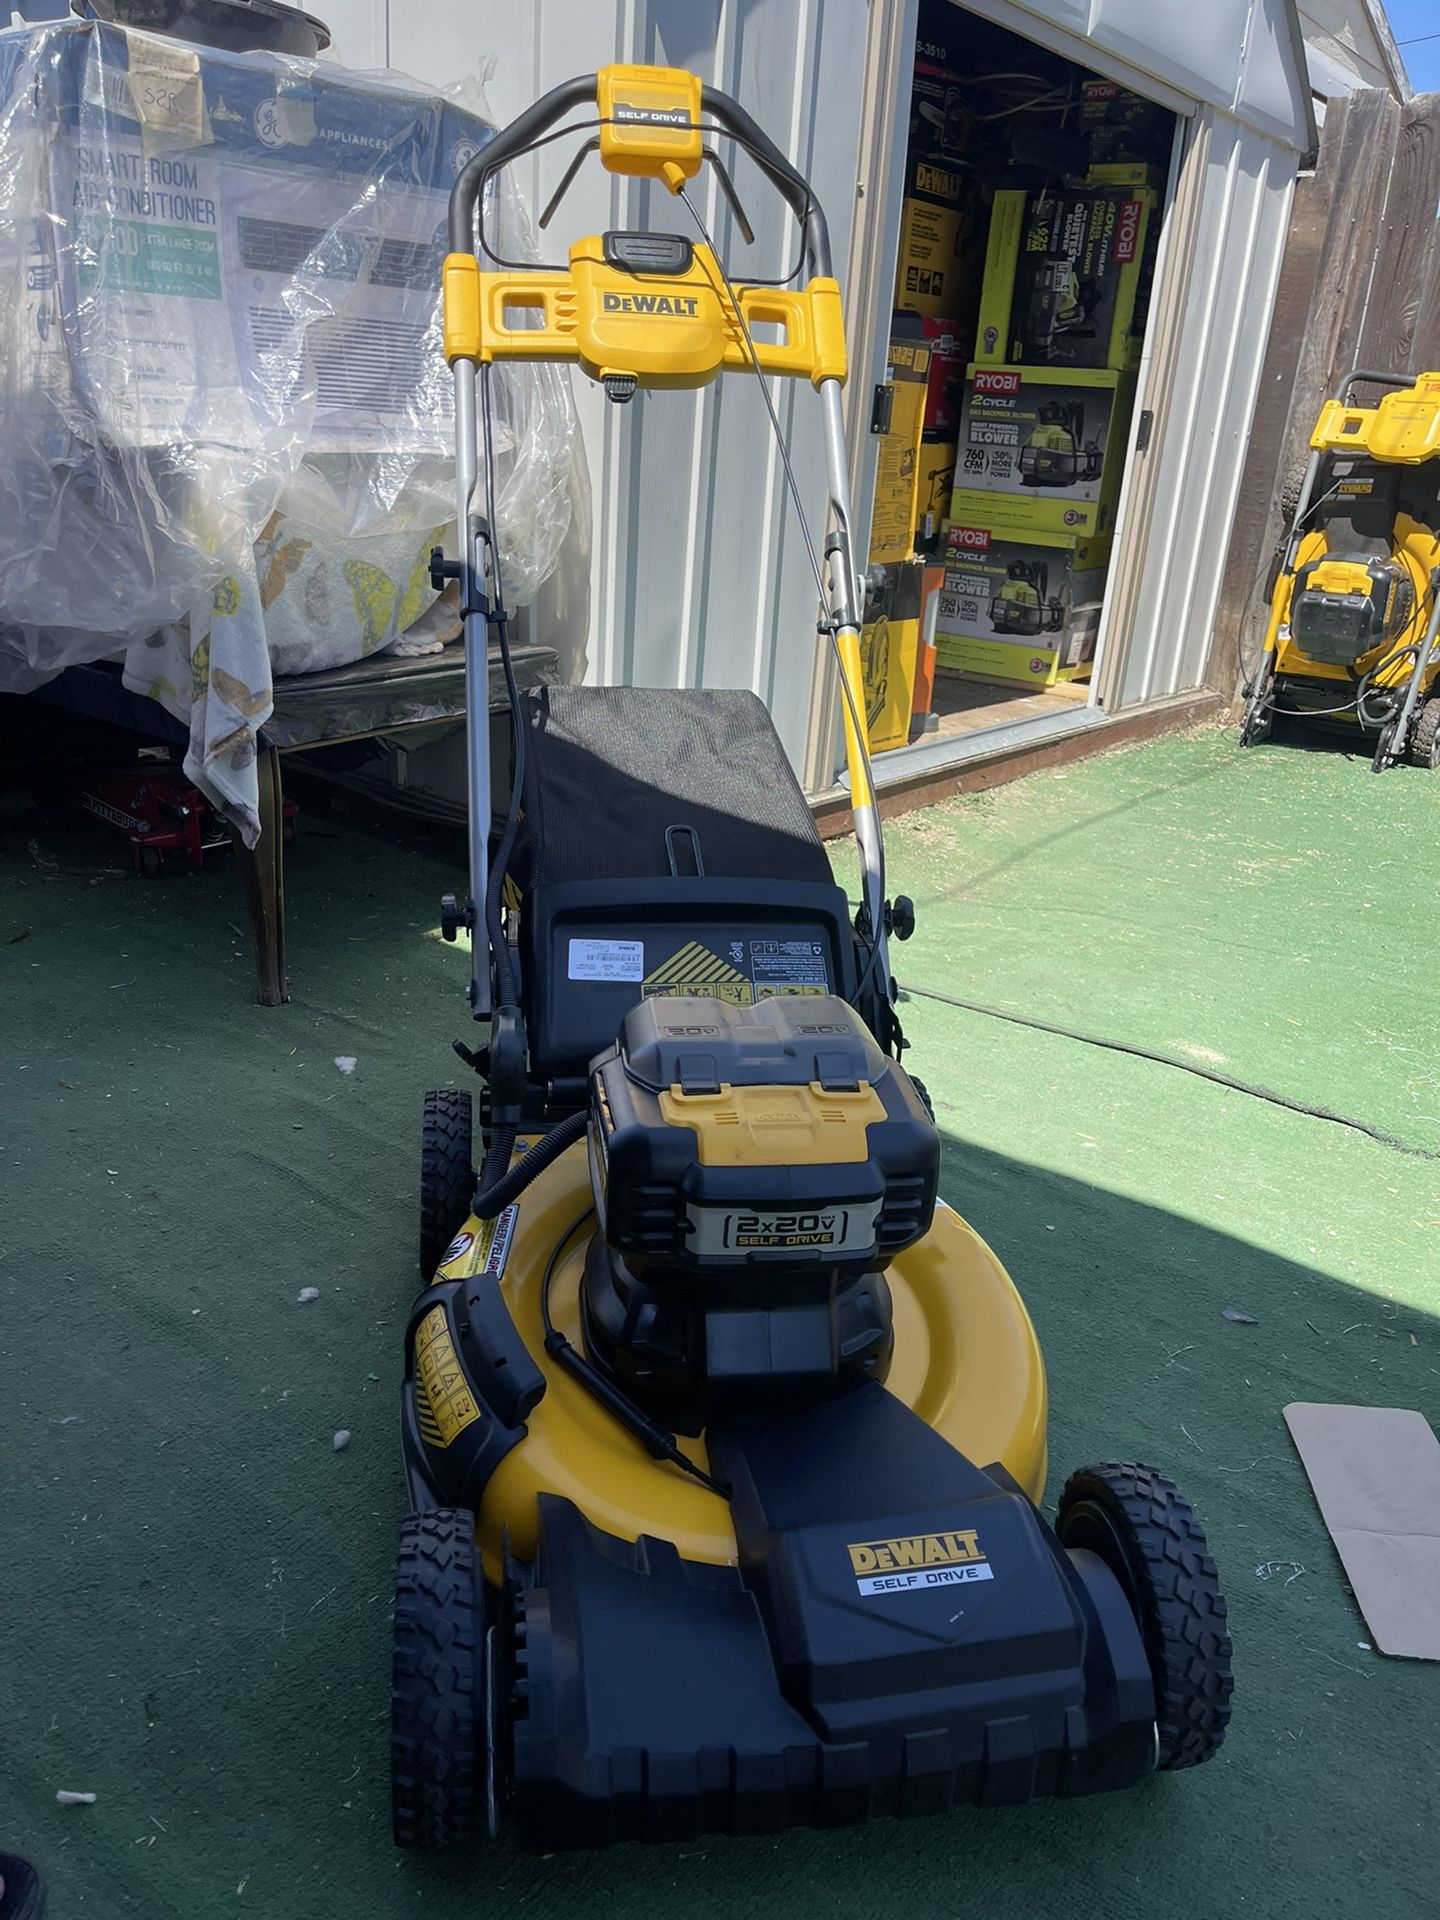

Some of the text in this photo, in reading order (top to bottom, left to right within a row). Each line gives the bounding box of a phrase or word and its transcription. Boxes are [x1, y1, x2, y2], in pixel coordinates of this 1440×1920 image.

[617, 111, 687, 123] SELF DRIVE
[319, 128, 390, 151] APPLIANCES
[78, 148, 198, 190] SMART ROOM
[109, 185, 216, 225] CONDITIONER
[1038, 227, 1050, 251] 625
[1062, 213, 1074, 252] BLOWER
[1067, 203, 1084, 263] QUIETEST
[1117, 204, 1139, 258] RYOBI
[1083, 242, 1094, 275] BLOWER
[603, 294, 698, 315] DEWALT
[976, 374, 1017, 390] RYOBI
[989, 423, 1019, 431] POWERFUL
[970, 431, 1018, 445] BLOWER
[965, 448, 984, 460] 760
[991, 459, 1012, 468] MORE
[993, 450, 1013, 460] 50%
[964, 460, 983, 470] CFM
[949, 528, 988, 546] RYOBI
[802, 1026, 848, 1034] 20V
[738, 1234, 832, 1245] SELF DRIVE
[848, 1532, 981, 1571] DEWALT
[872, 1568, 979, 1591] SELF DRIVE
